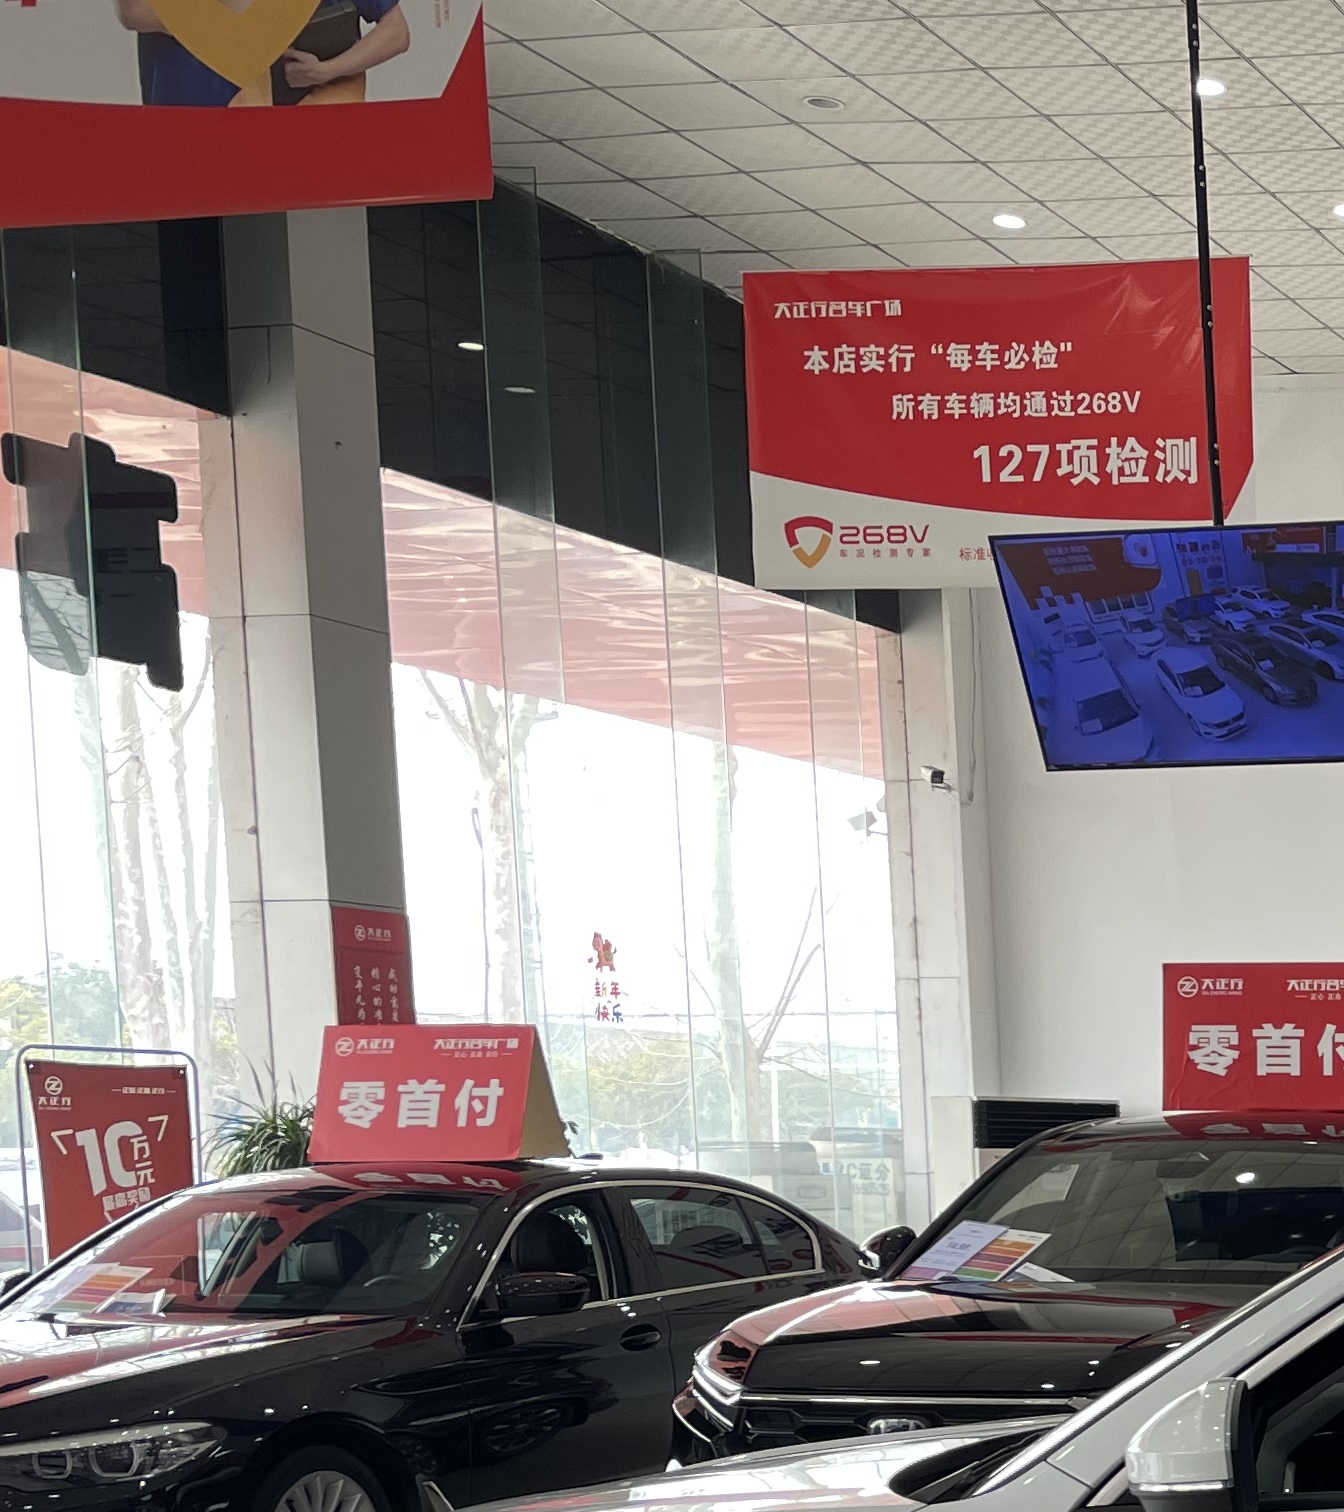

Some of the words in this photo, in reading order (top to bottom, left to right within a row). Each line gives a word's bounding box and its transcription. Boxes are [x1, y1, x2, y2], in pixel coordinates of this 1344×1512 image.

[774, 299, 902, 319] 大正行名车广场
[892, 391, 1141, 421] 所有车辆均通过268V
[973, 436, 1198, 486] 127项检测
[839, 524, 930, 545] 268V
[594, 977, 621, 999] 新年
[1202, 978, 1243, 990] 大正行
[595, 1003, 623, 1023] 快乐
[338, 1079, 504, 1129] 零首付
[75, 1120, 144, 1196] 10
